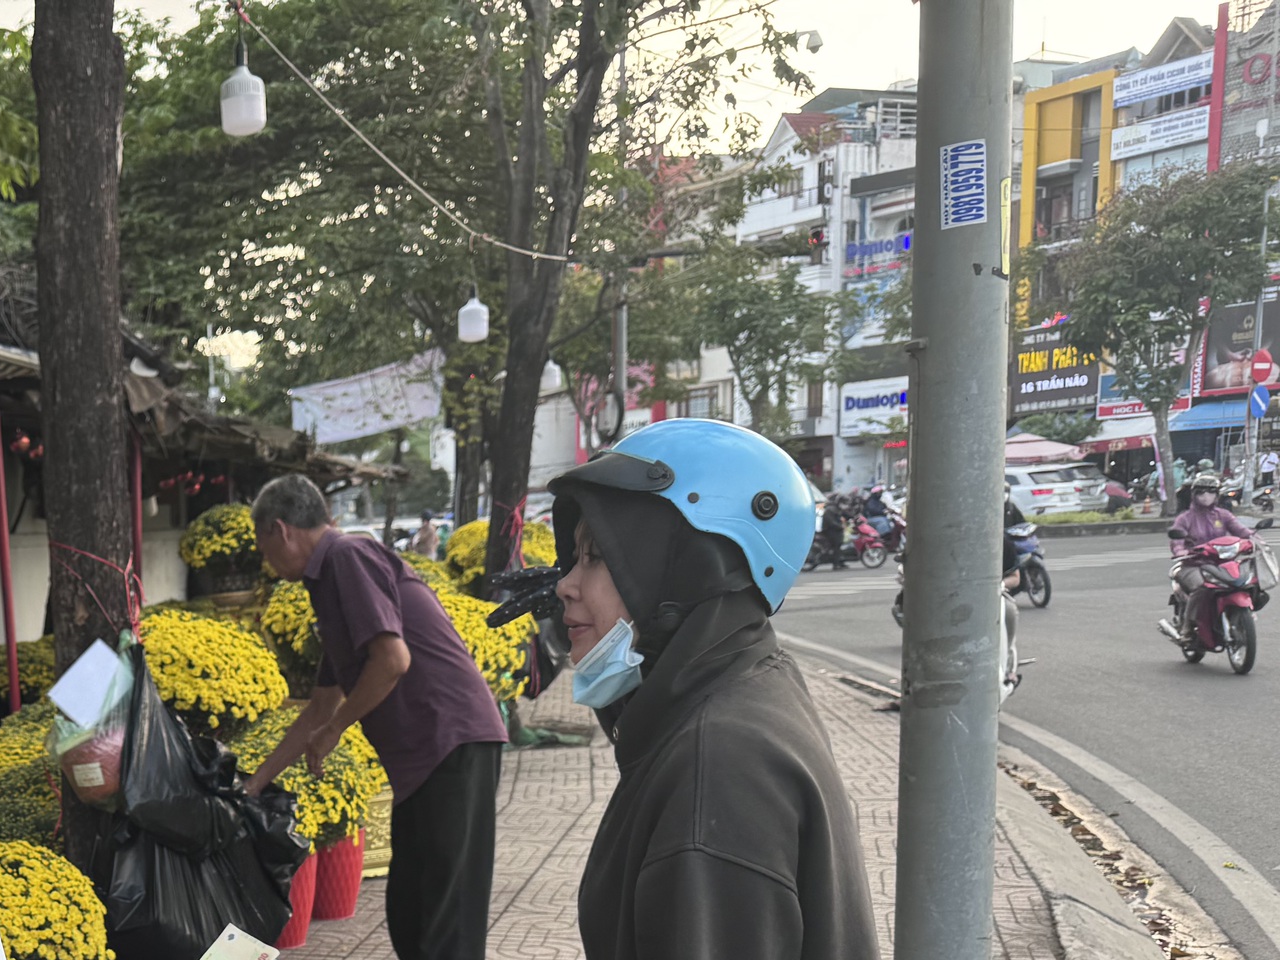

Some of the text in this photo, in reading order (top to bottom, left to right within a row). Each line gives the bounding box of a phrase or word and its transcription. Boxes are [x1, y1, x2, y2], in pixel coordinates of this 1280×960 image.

[950, 142, 985, 223] 0981.959.779
[1020, 382, 1034, 394] 16
[1065, 373, 1089, 388] NÃO
[845, 392, 900, 411] Dunlop
